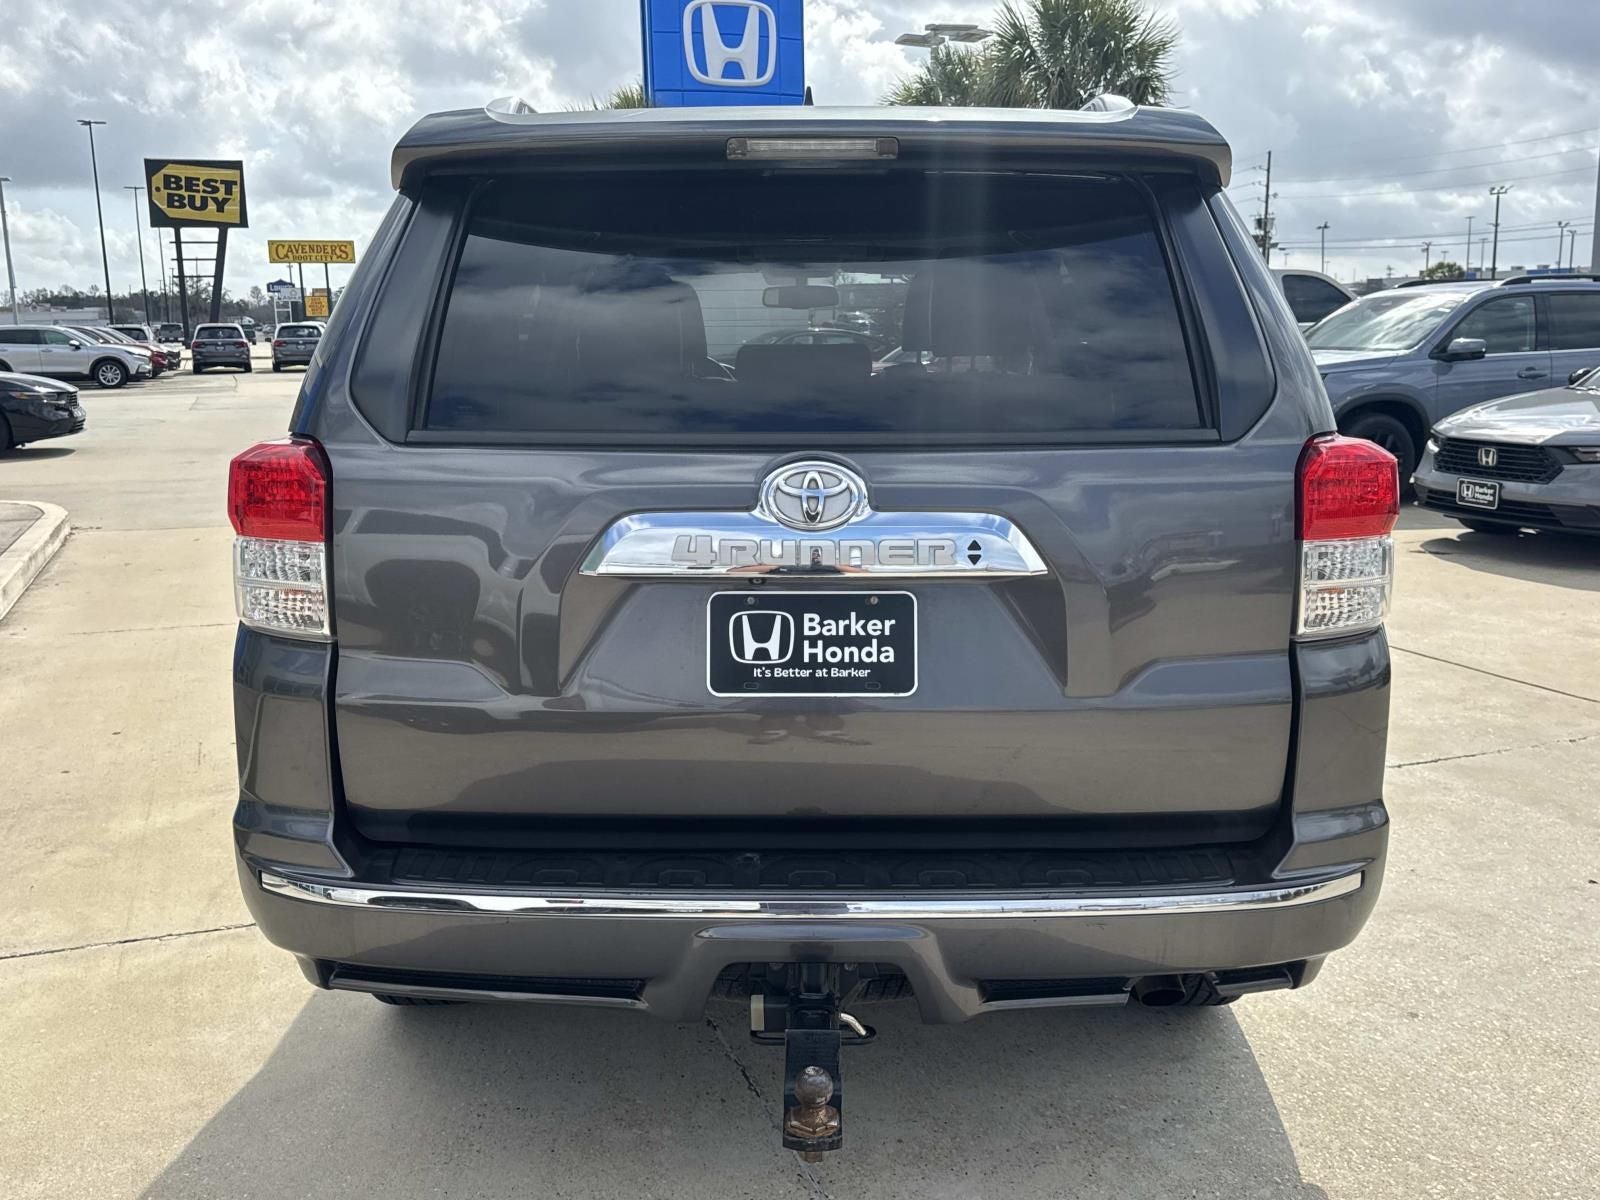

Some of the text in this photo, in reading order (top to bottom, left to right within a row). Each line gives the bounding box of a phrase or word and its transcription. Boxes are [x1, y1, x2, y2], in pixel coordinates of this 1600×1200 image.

[162, 174, 238, 196] BEST
[166, 192, 231, 213] BUY
[275, 243, 349, 260] CAVENDER'S
[671, 534, 958, 567] 4RUNNER
[803, 612, 896, 636] Barker
[803, 639, 895, 663] Honda
[753, 667, 871, 678] It's Better at Barker
